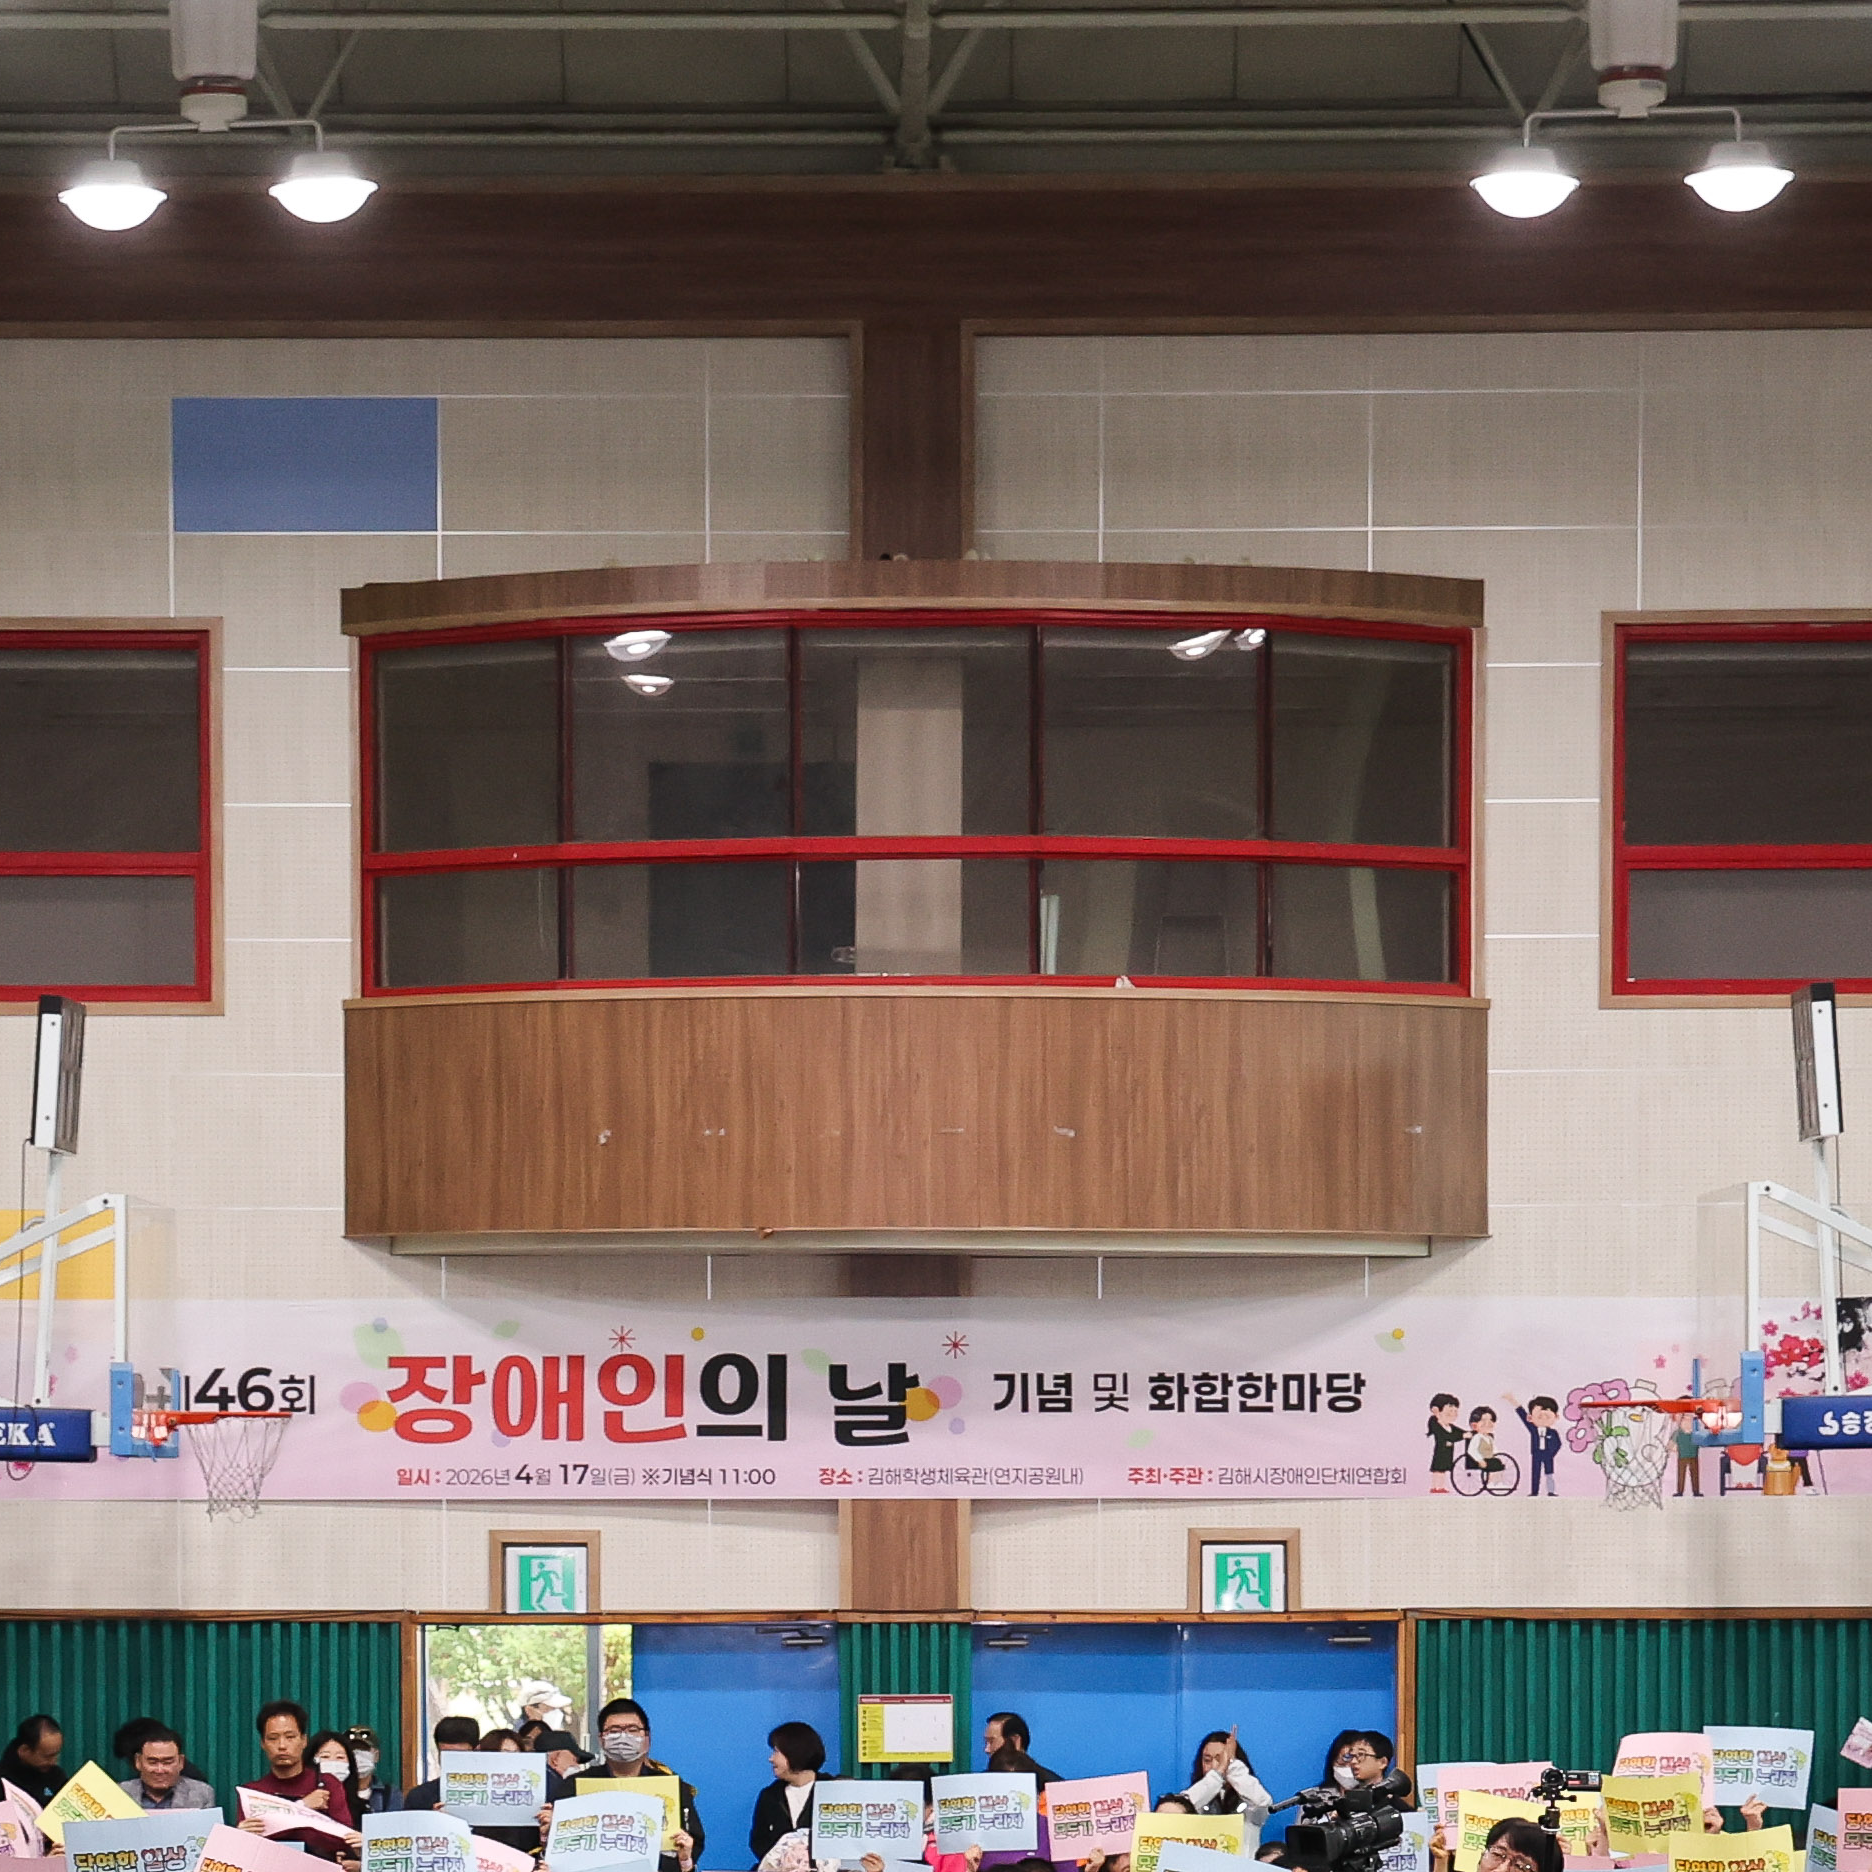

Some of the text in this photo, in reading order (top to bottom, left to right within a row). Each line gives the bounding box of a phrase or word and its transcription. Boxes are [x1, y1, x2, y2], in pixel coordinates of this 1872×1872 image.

[386, 1352, 788, 1444] 장애인의
[828, 1361, 921, 1447] 날
[992, 1372, 1073, 1413] 기념
[1092, 1372, 1130, 1413] 및
[1147, 1371, 1366, 1414] 화합한마당
[396, 1468, 430, 1486] 일시
[445, 1467, 510, 1486] 2026년
[514, 1463, 552, 1486] 4월
[559, 1463, 636, 1487] 17일(금)
[719, 1468, 776, 1485] 11:00
[818, 1467, 853, 1485] 장소
